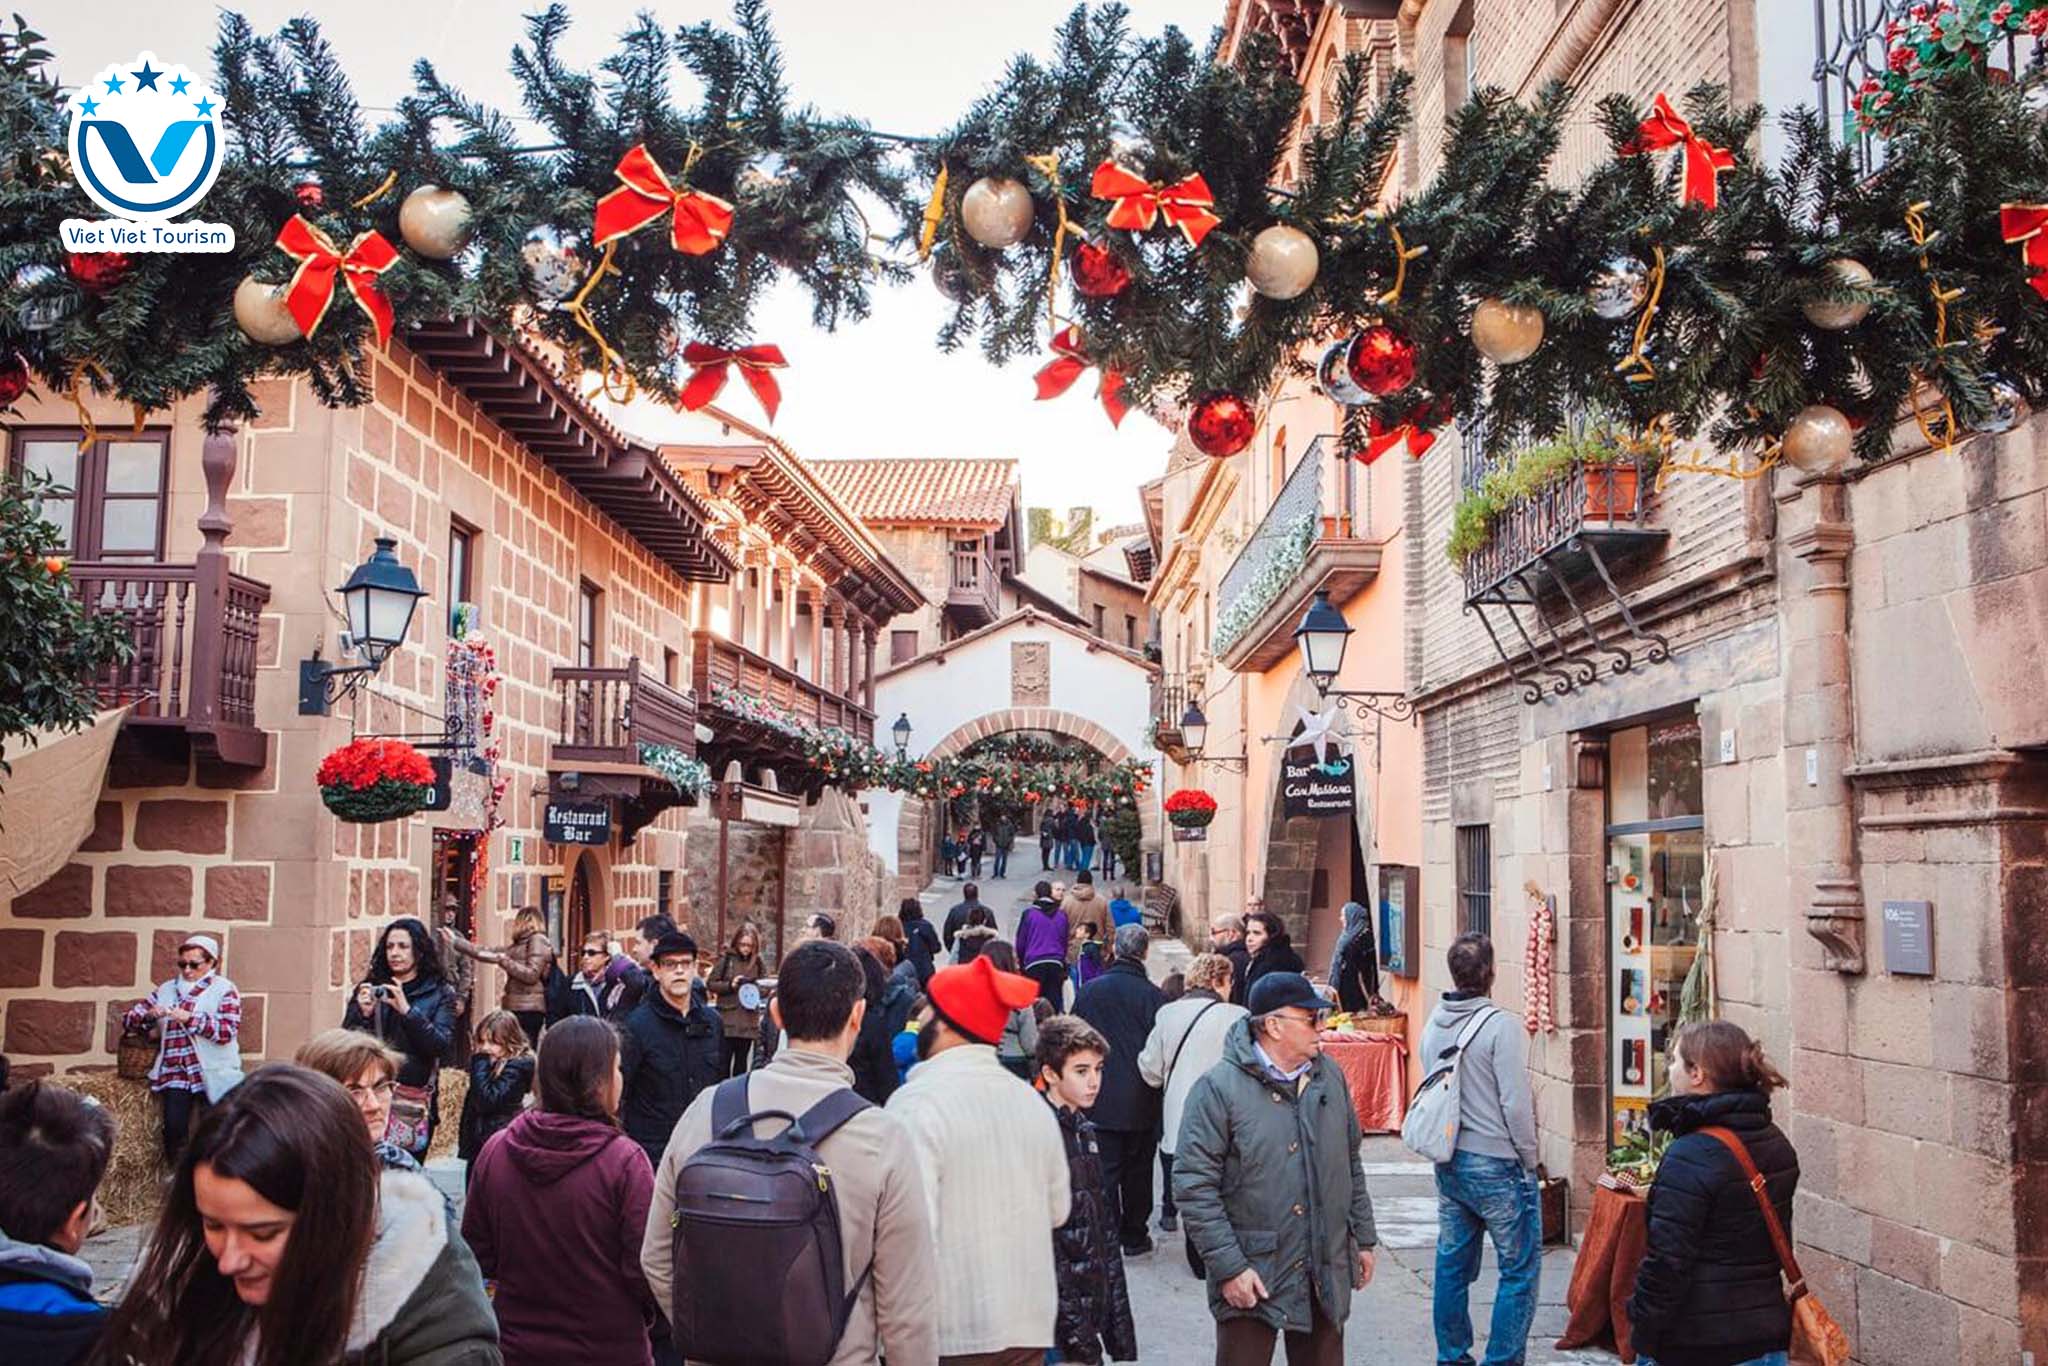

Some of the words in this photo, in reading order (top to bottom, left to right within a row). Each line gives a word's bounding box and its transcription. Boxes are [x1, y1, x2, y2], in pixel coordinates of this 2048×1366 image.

[1286, 765, 1310, 778] Bar
[549, 806, 606, 826] Restaurant
[562, 825, 593, 841] Bar
